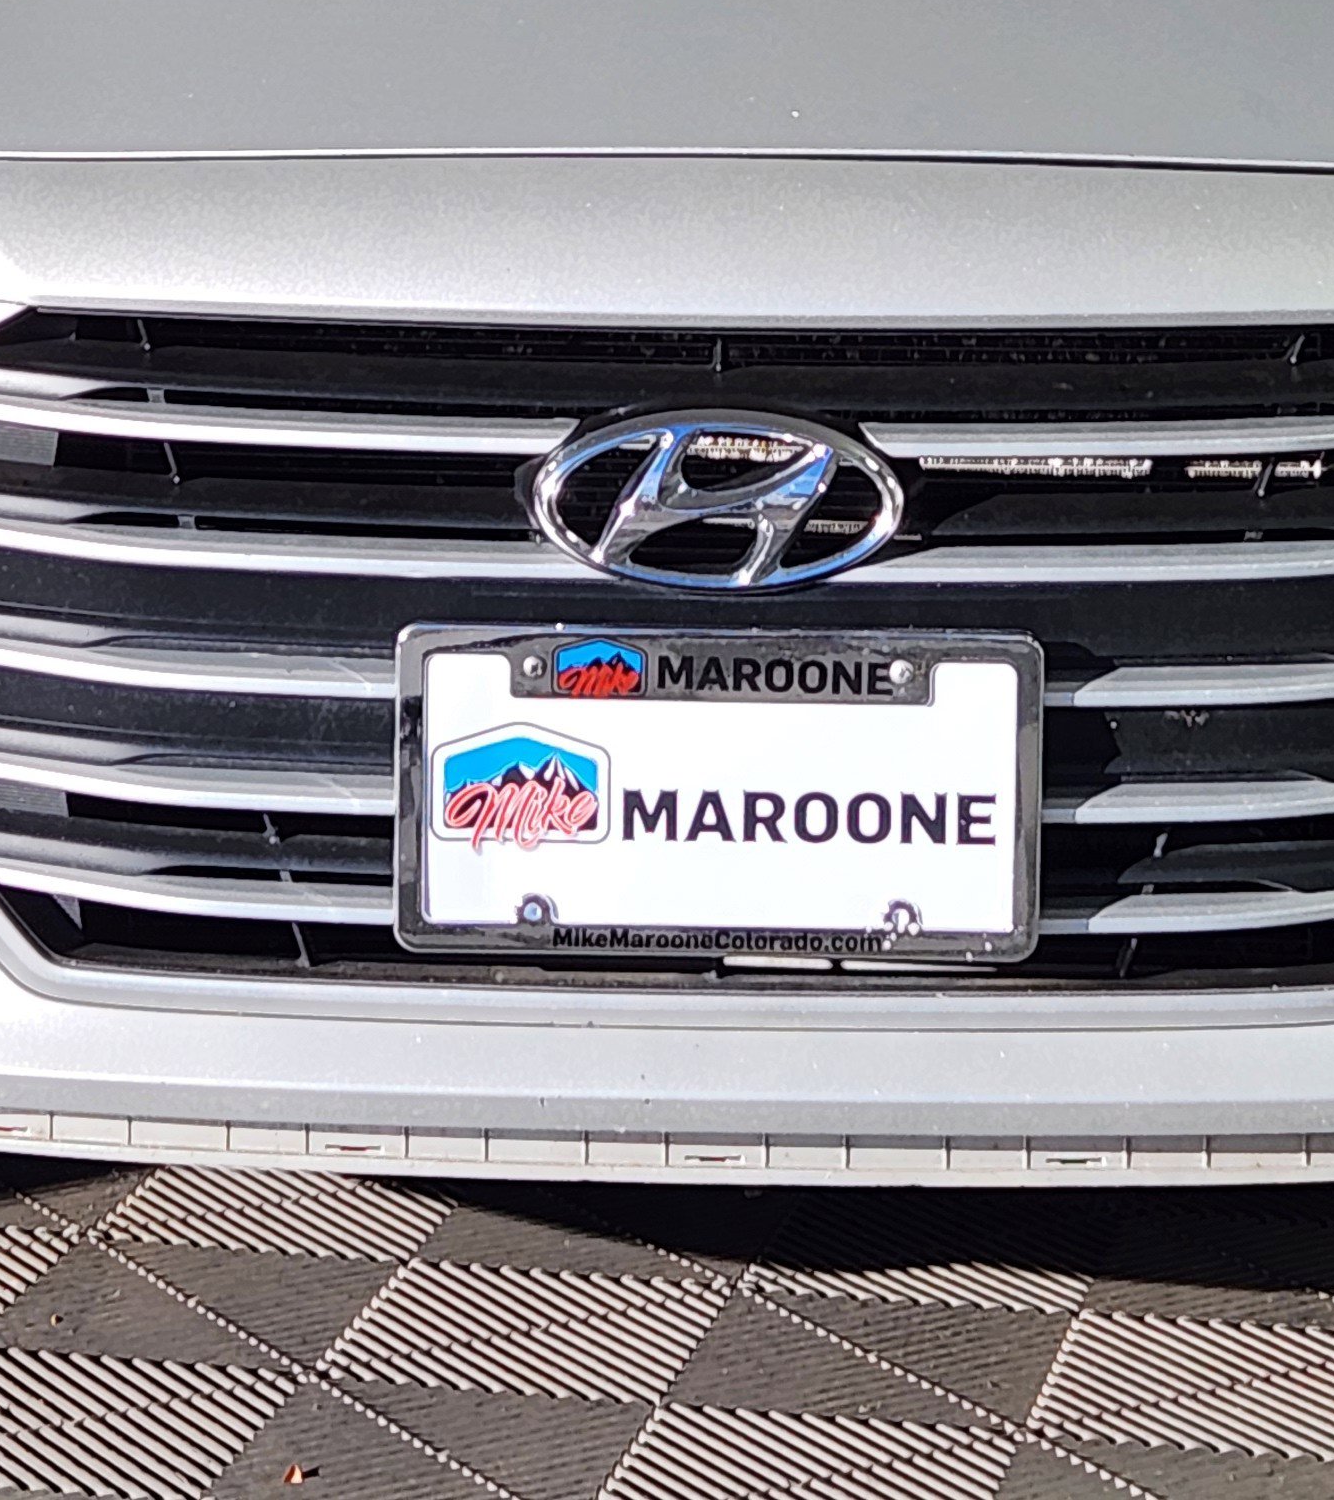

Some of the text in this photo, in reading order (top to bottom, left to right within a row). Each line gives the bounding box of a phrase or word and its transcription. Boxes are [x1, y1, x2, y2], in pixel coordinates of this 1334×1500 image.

[657, 655, 894, 696] MAROONE
[445, 777, 998, 854] Mike MAROONE
[551, 927, 884, 952] MikeMarooneColorado.com
